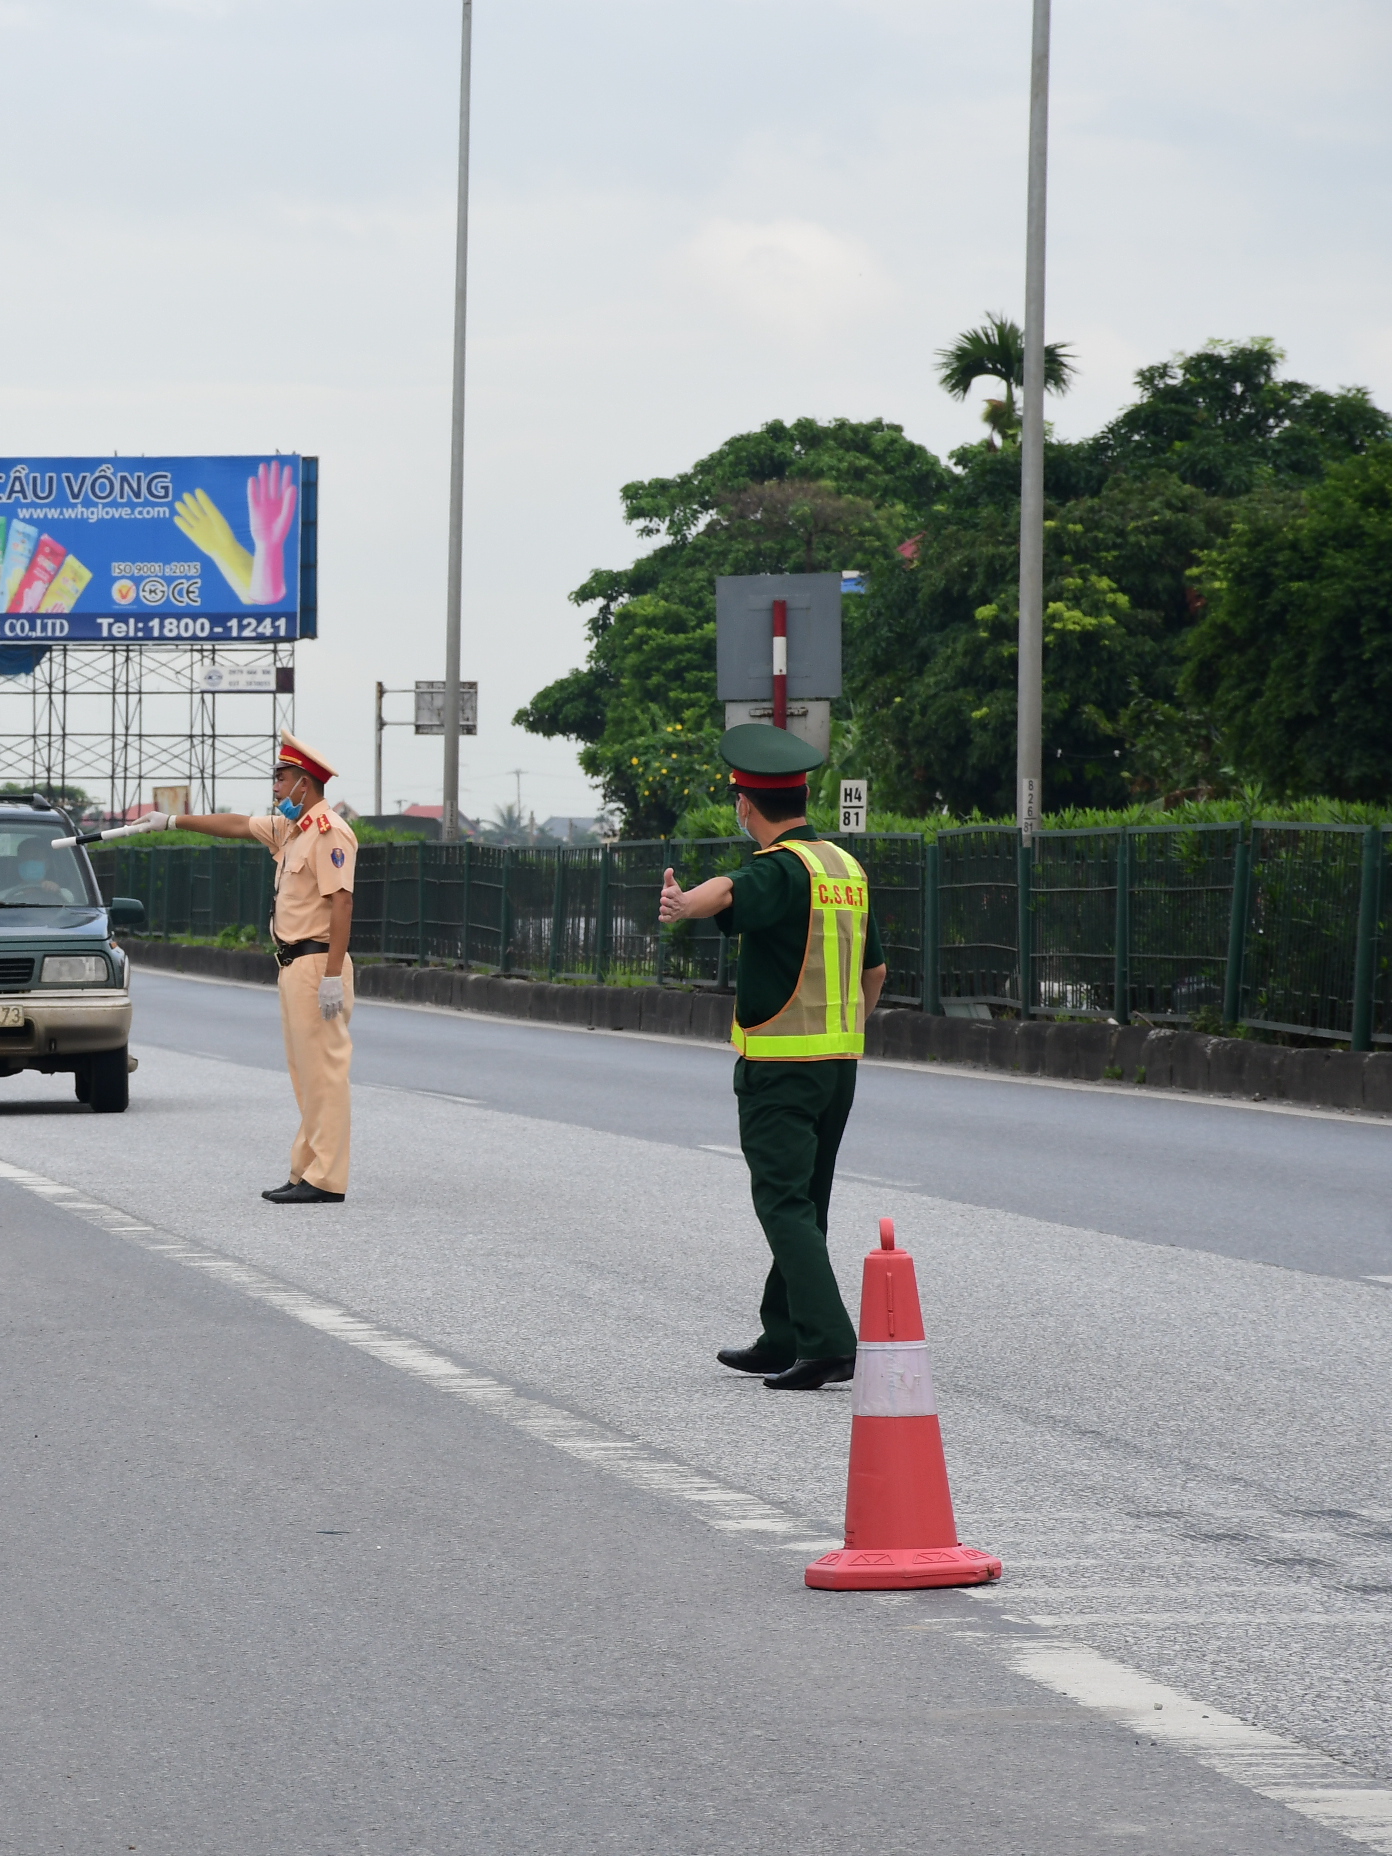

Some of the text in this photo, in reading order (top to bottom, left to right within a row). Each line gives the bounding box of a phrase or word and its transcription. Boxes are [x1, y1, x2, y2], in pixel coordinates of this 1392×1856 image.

[63, 464, 172, 502] VỒNG
[17, 503, 169, 523] www.whglove.com
[112, 562, 133, 576] ISO
[843, 787, 862, 803] H4
[842, 811, 860, 827] 81
[818, 883, 864, 907] C.S.G.T
